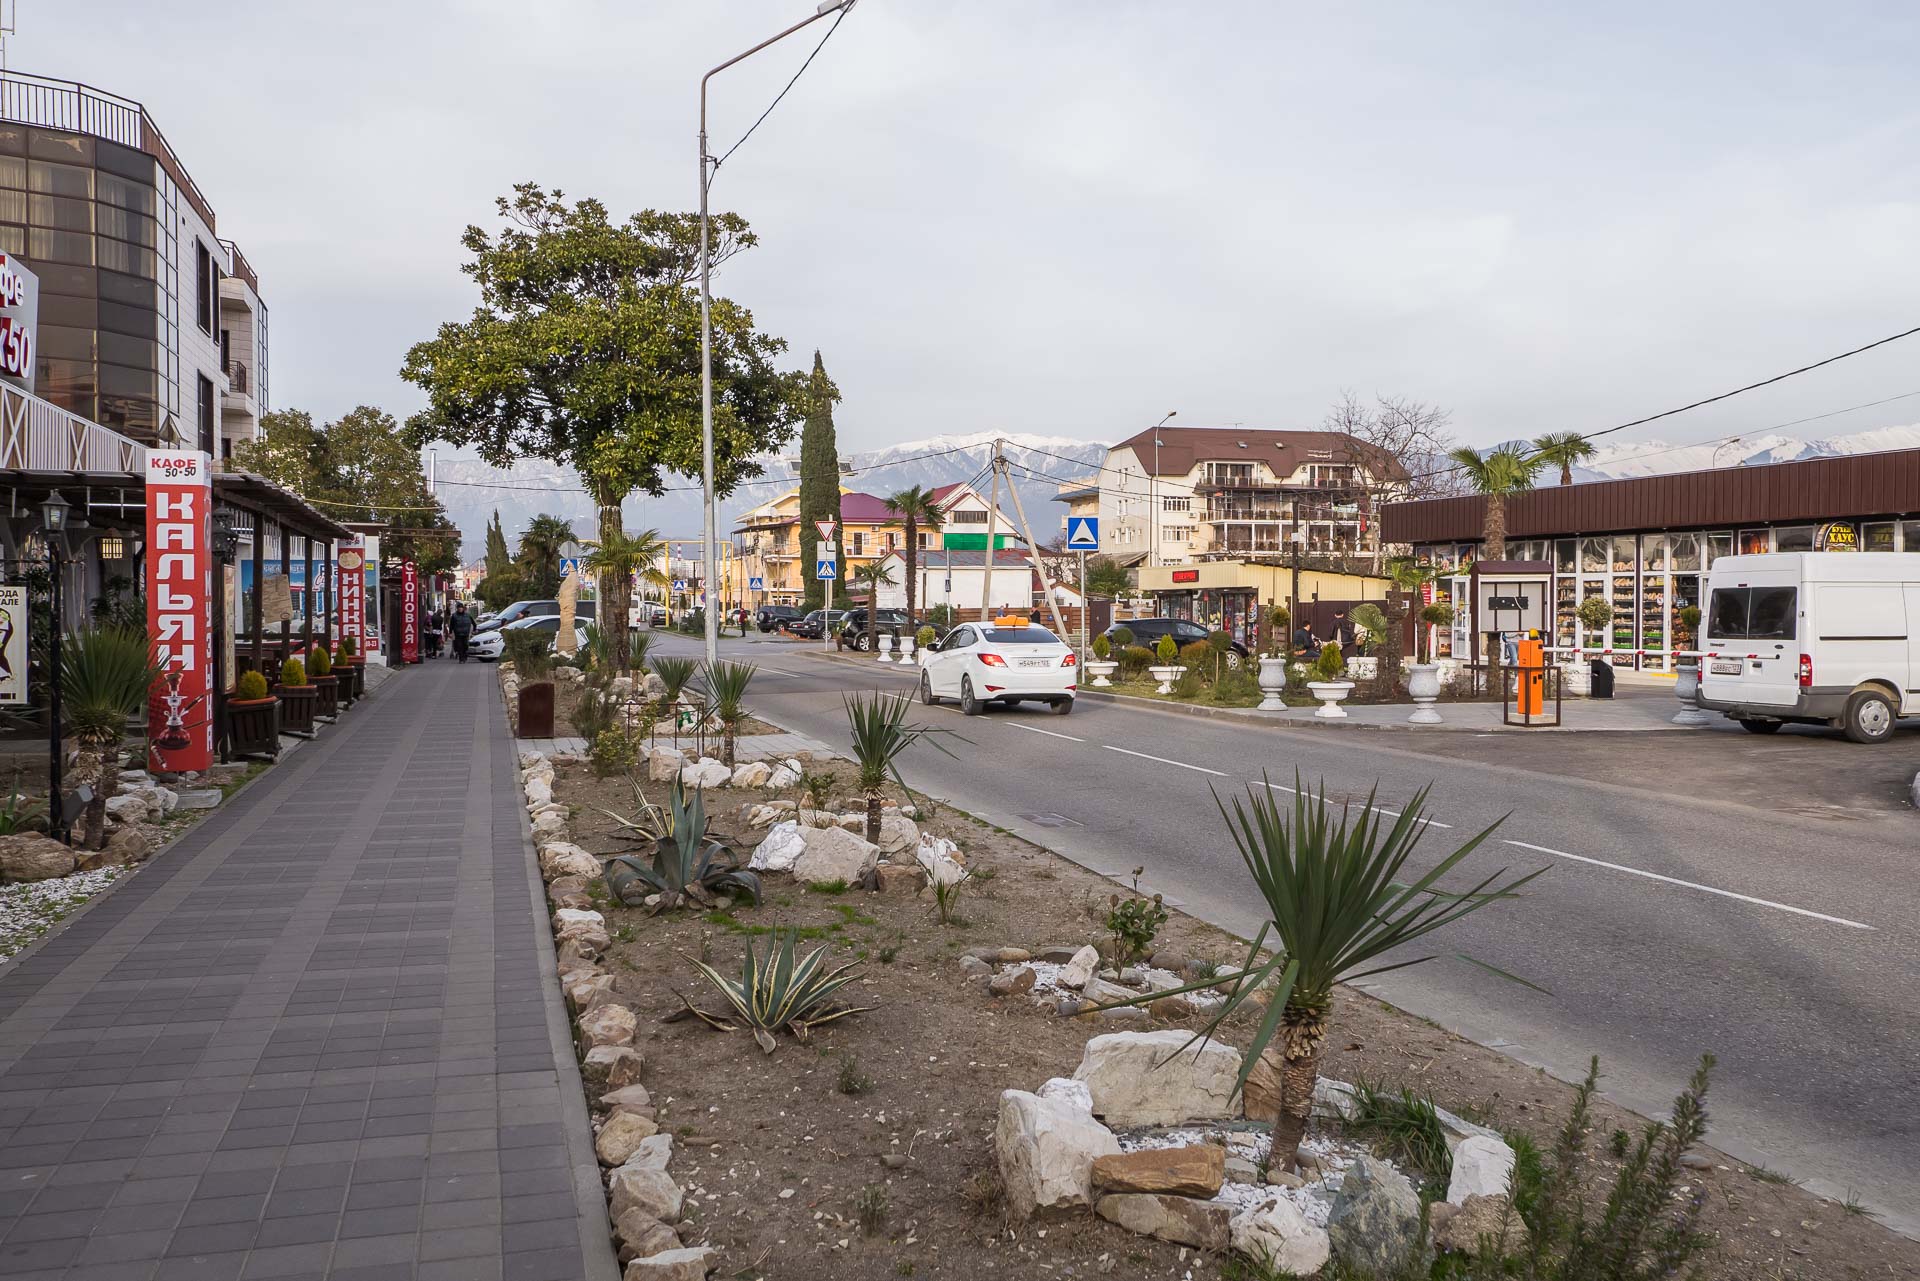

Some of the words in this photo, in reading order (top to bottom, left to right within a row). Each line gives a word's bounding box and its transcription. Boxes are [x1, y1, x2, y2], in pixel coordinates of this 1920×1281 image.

[151, 457, 197, 469] КАФЕ
[1829, 532, 1855, 543] ХАУС
[156, 492, 194, 671] КАЛЬЯН
[405, 561, 415, 644] СТОЛОВАЯ
